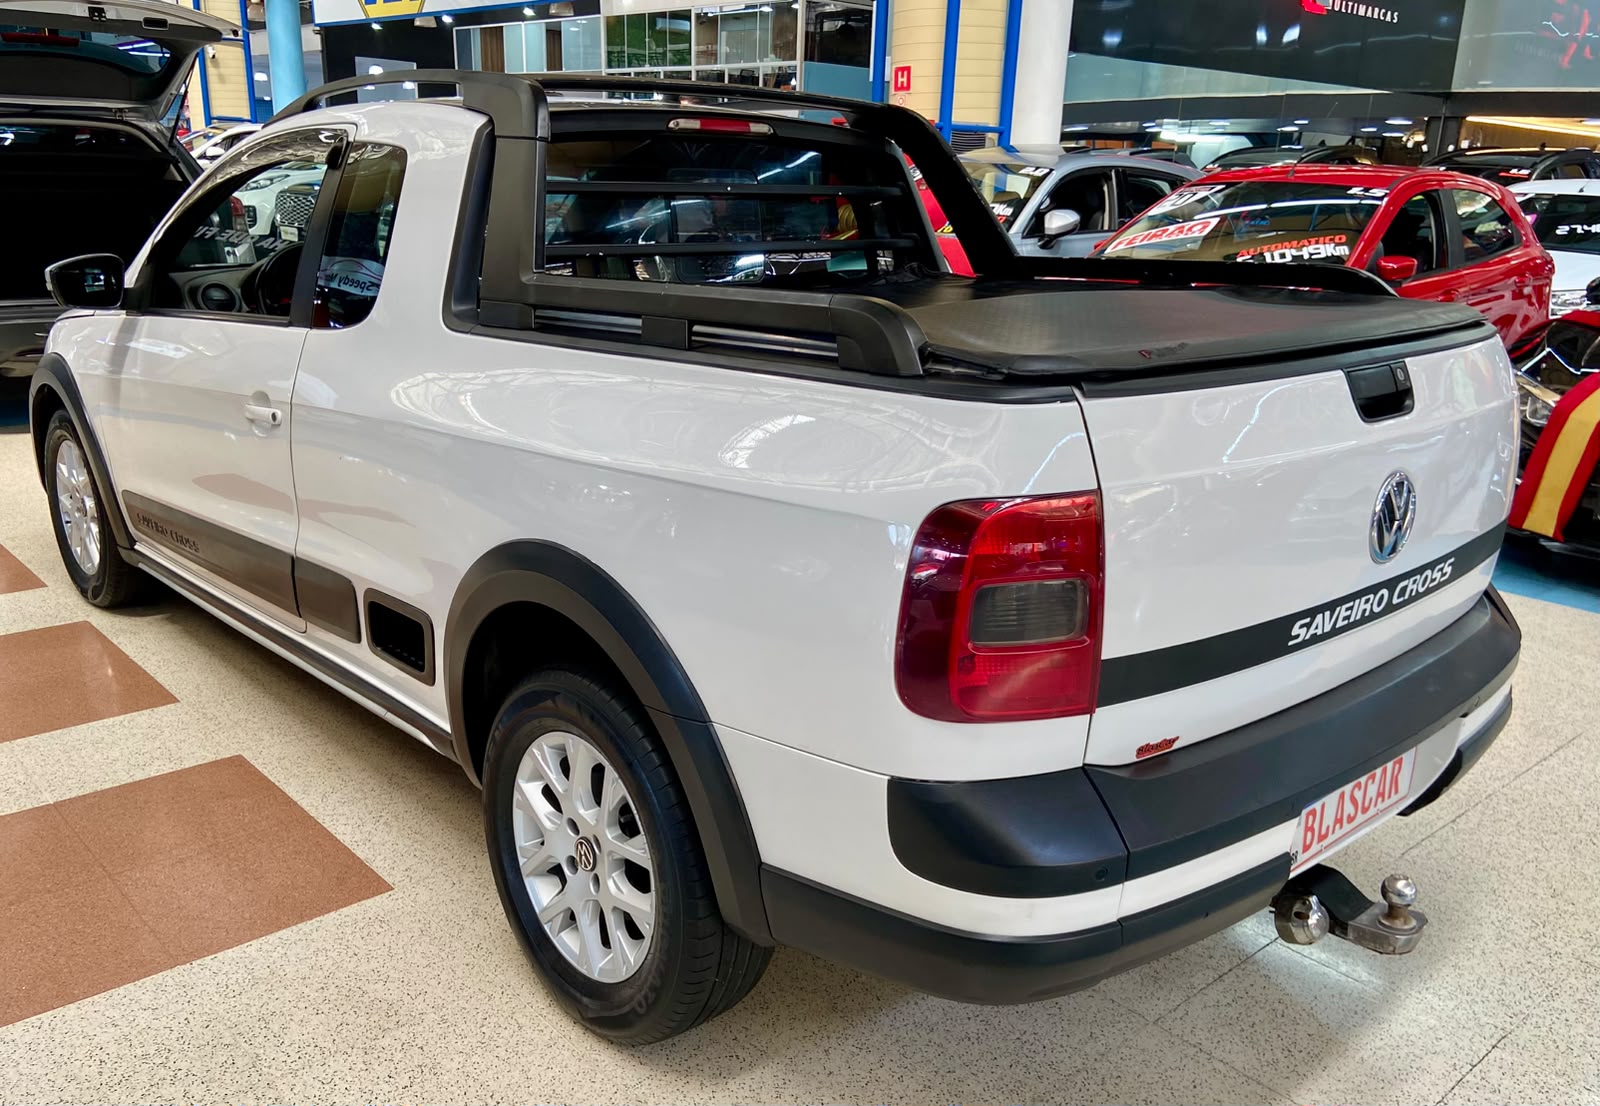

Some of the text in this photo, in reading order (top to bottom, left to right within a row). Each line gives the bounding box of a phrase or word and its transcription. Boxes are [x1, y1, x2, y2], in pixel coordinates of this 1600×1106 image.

[897, 70, 908, 88] H
[1236, 234, 1347, 258] AUTOMATICO
[1287, 557, 1456, 647] SAVEIRO CROSS
[1301, 756, 1404, 855] BLASCAR
